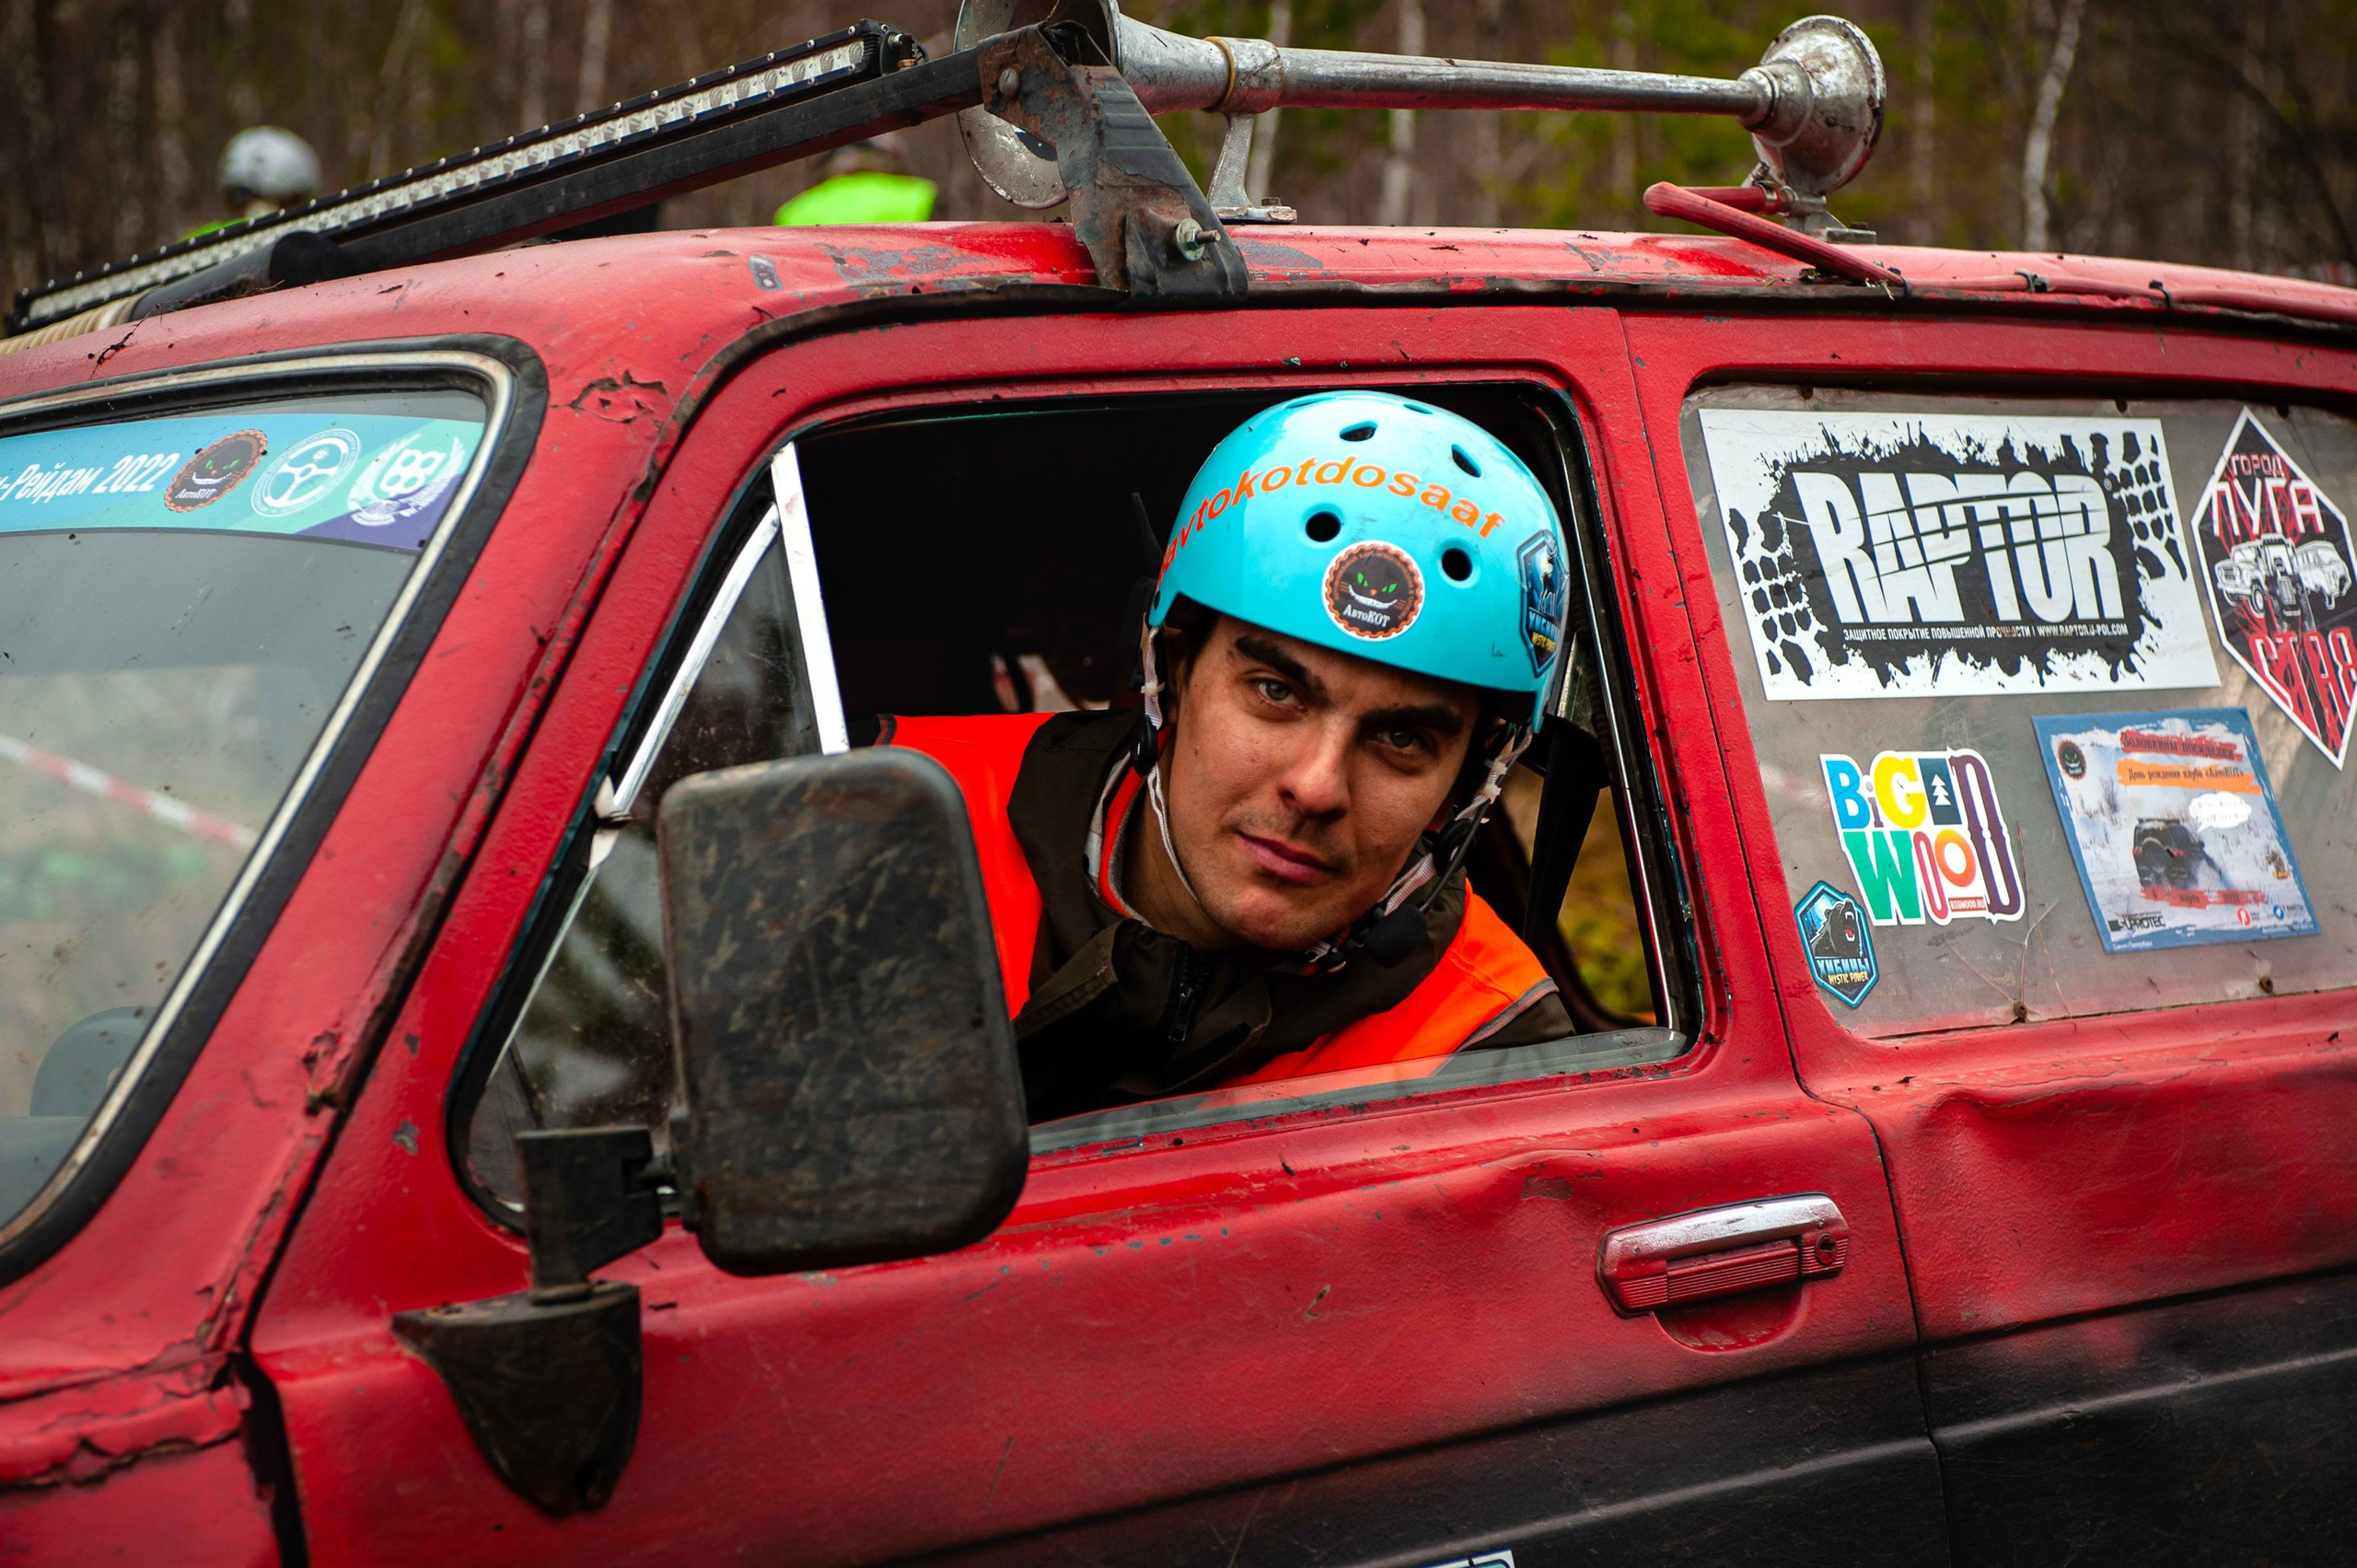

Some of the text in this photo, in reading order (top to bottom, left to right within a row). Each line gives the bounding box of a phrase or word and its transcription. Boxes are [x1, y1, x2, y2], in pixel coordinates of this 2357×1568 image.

[91, 452, 180, 494] 2022
[2230, 453, 2285, 478] ГОРОД
[1792, 470, 2125, 624] RAPTOR
[1342, 604, 1390, 627] АвтоКОТ
[1843, 629, 1887, 642] ЗАЩИТНОЕ
[1887, 628, 1930, 640] ПОКРЫТИЕ
[1932, 624, 1985, 640] ПОВЫШЕННОЙ
[1828, 970, 1870, 985] MYSTIC POWER
